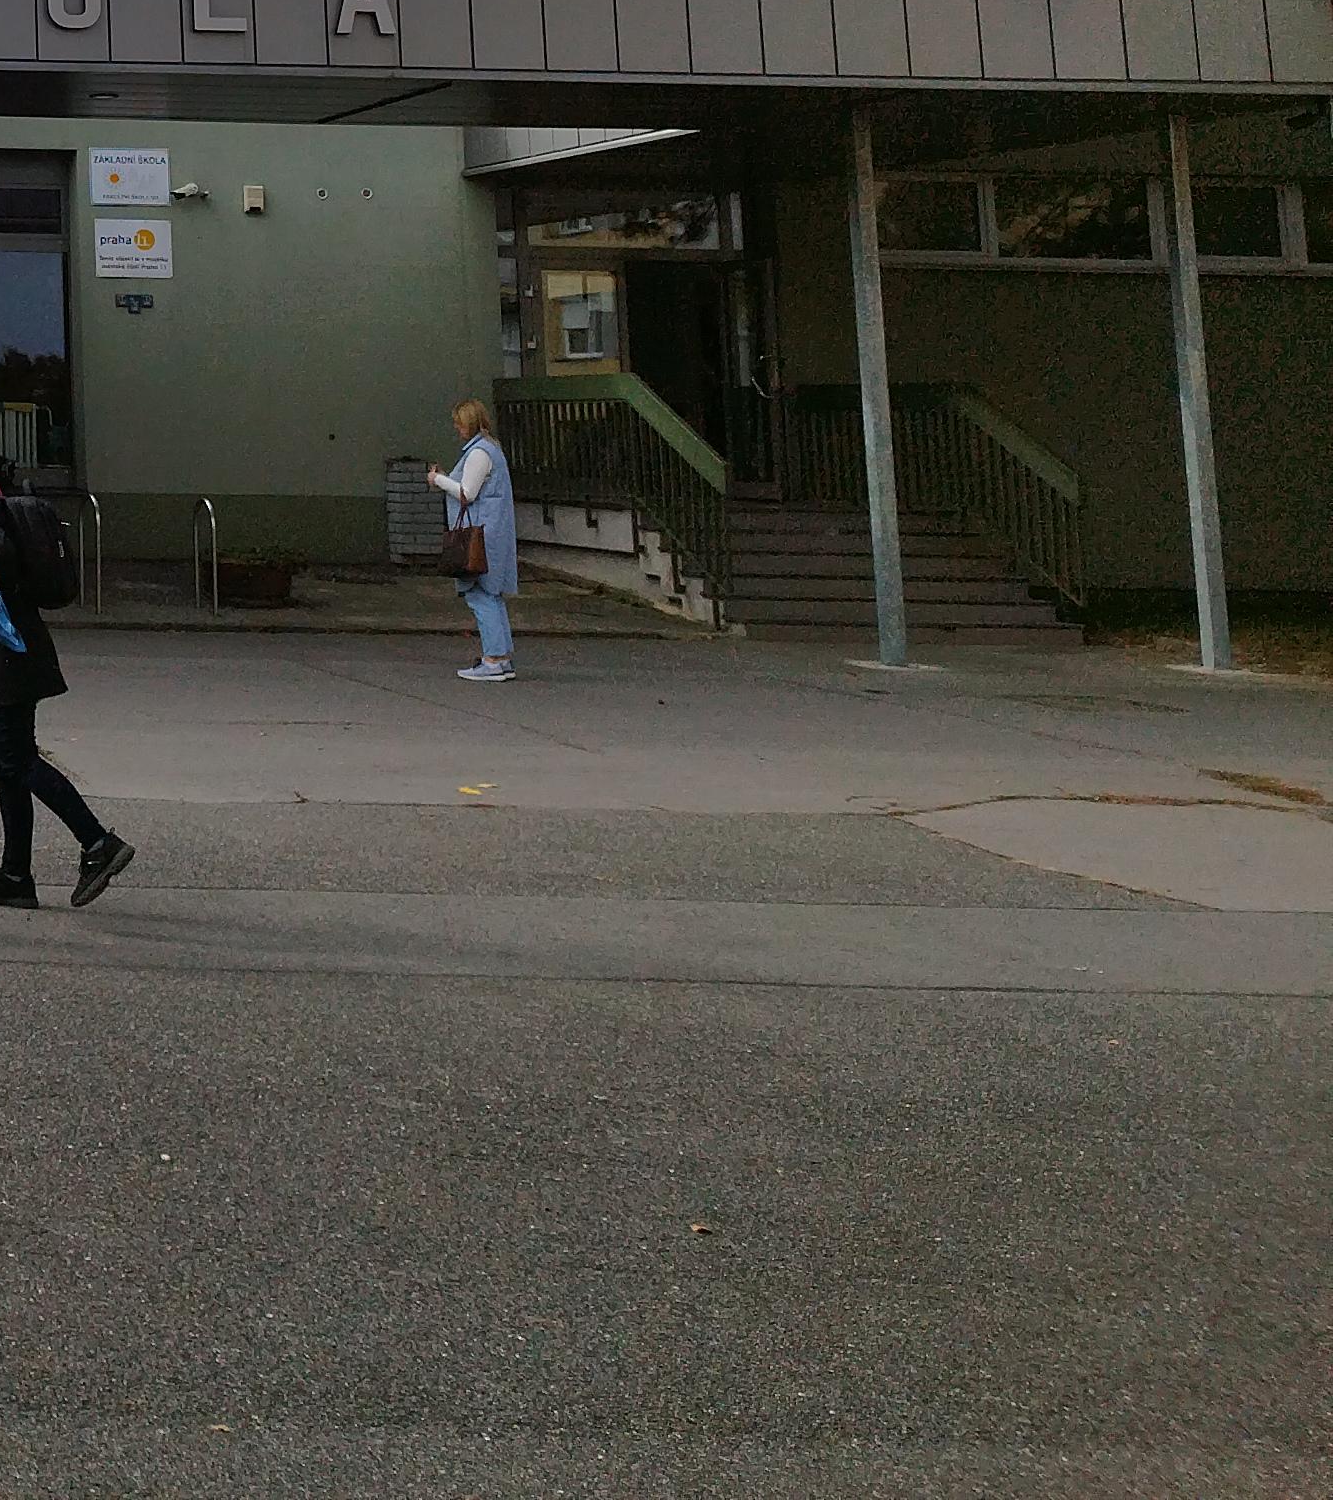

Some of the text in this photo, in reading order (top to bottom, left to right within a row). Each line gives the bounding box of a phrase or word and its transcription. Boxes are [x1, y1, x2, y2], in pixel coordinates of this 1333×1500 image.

[93, 153, 167, 165] ZÁKLADNÍ ŠKOLA
[100, 234, 132, 246] praha
